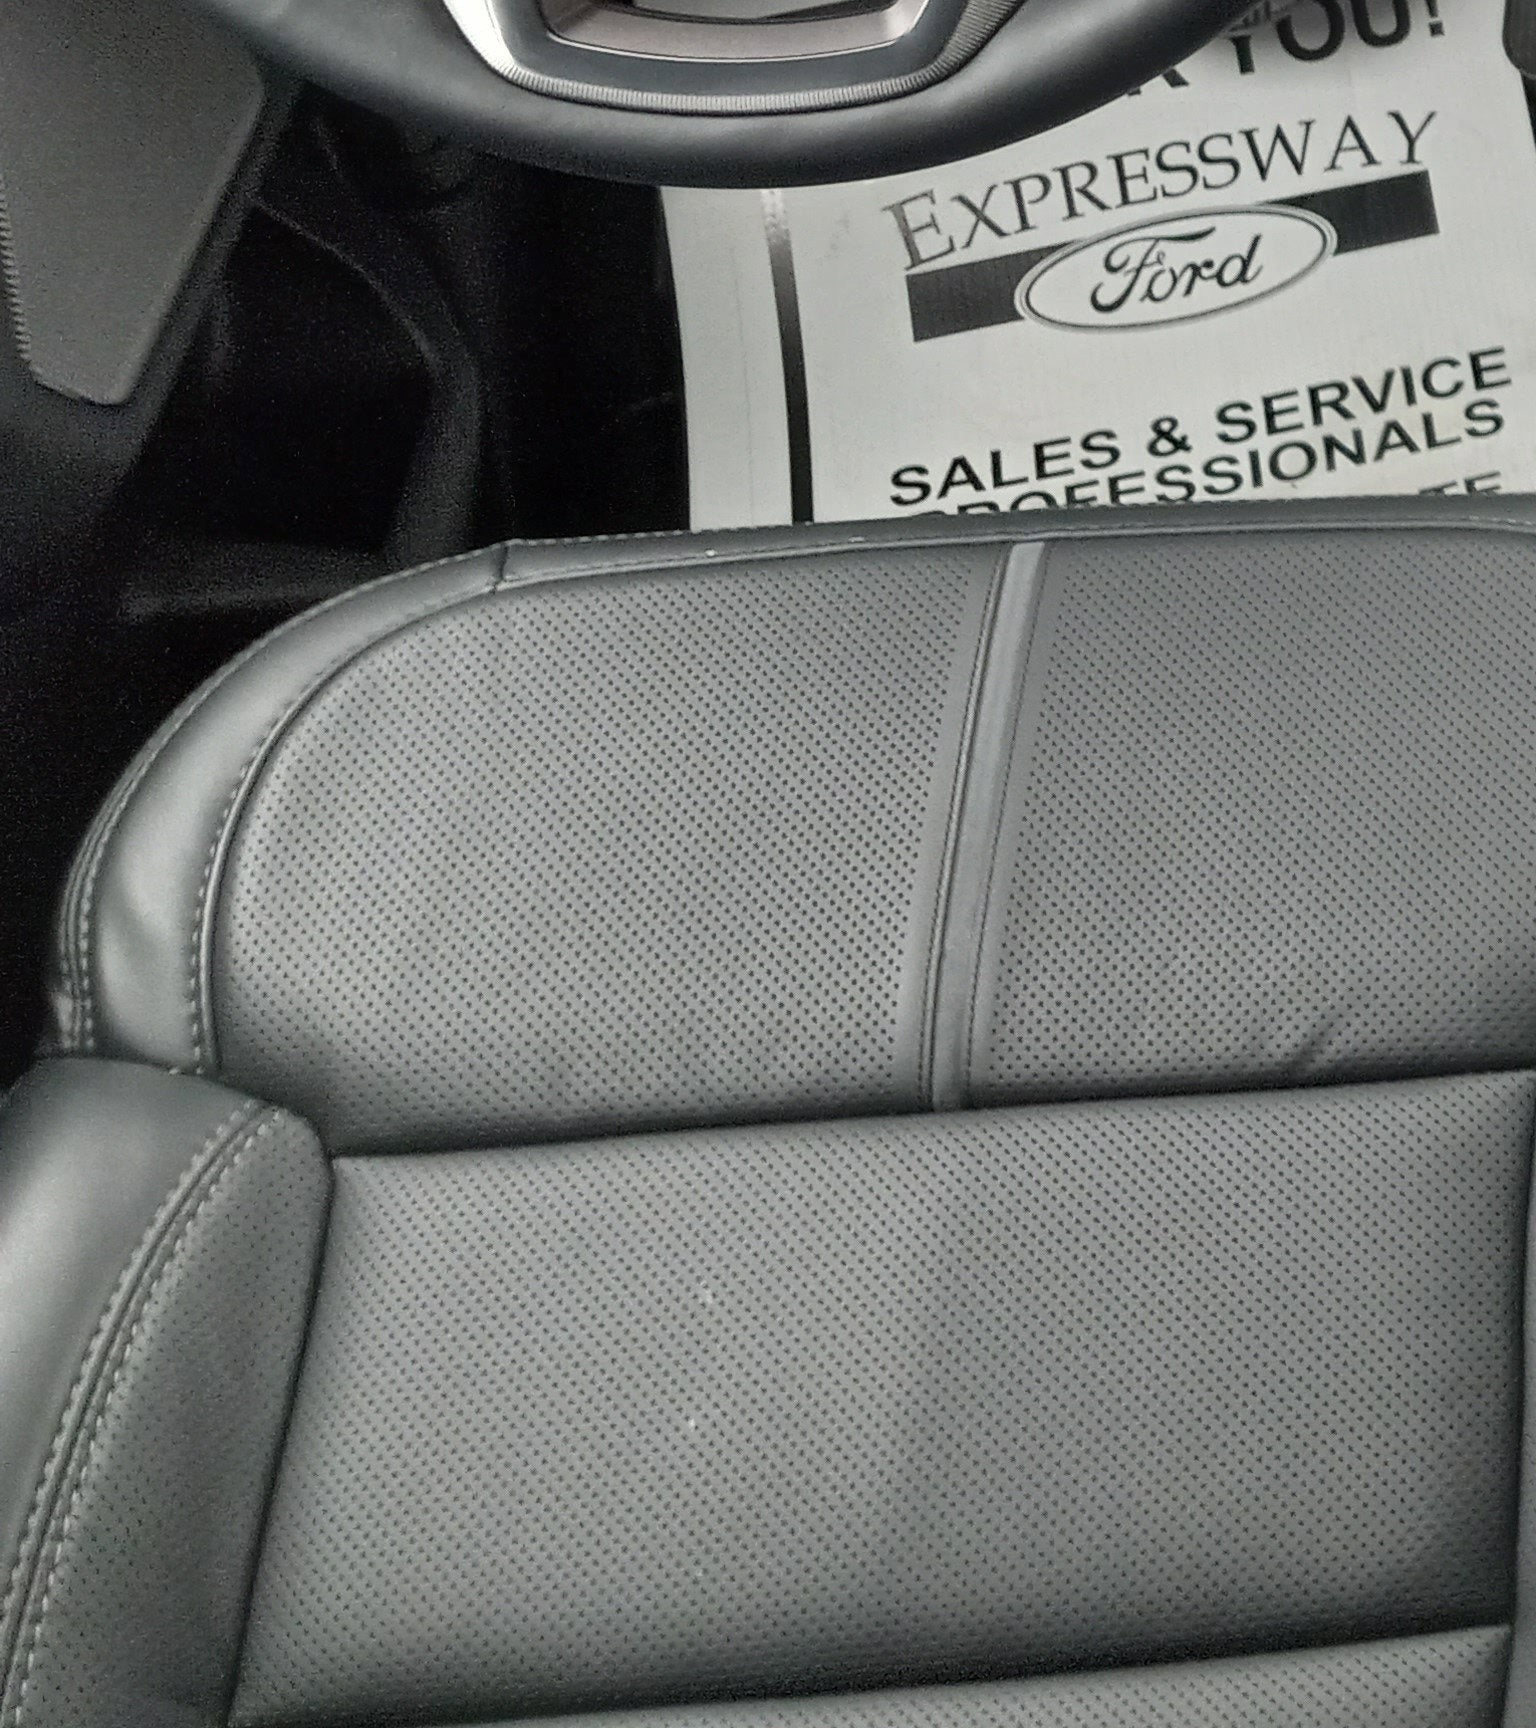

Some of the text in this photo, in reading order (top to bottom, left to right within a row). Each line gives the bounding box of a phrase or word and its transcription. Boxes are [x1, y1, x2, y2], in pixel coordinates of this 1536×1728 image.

[1089, 226, 1264, 313] Ford
[889, 345, 1512, 507] SALES & SERVICE
